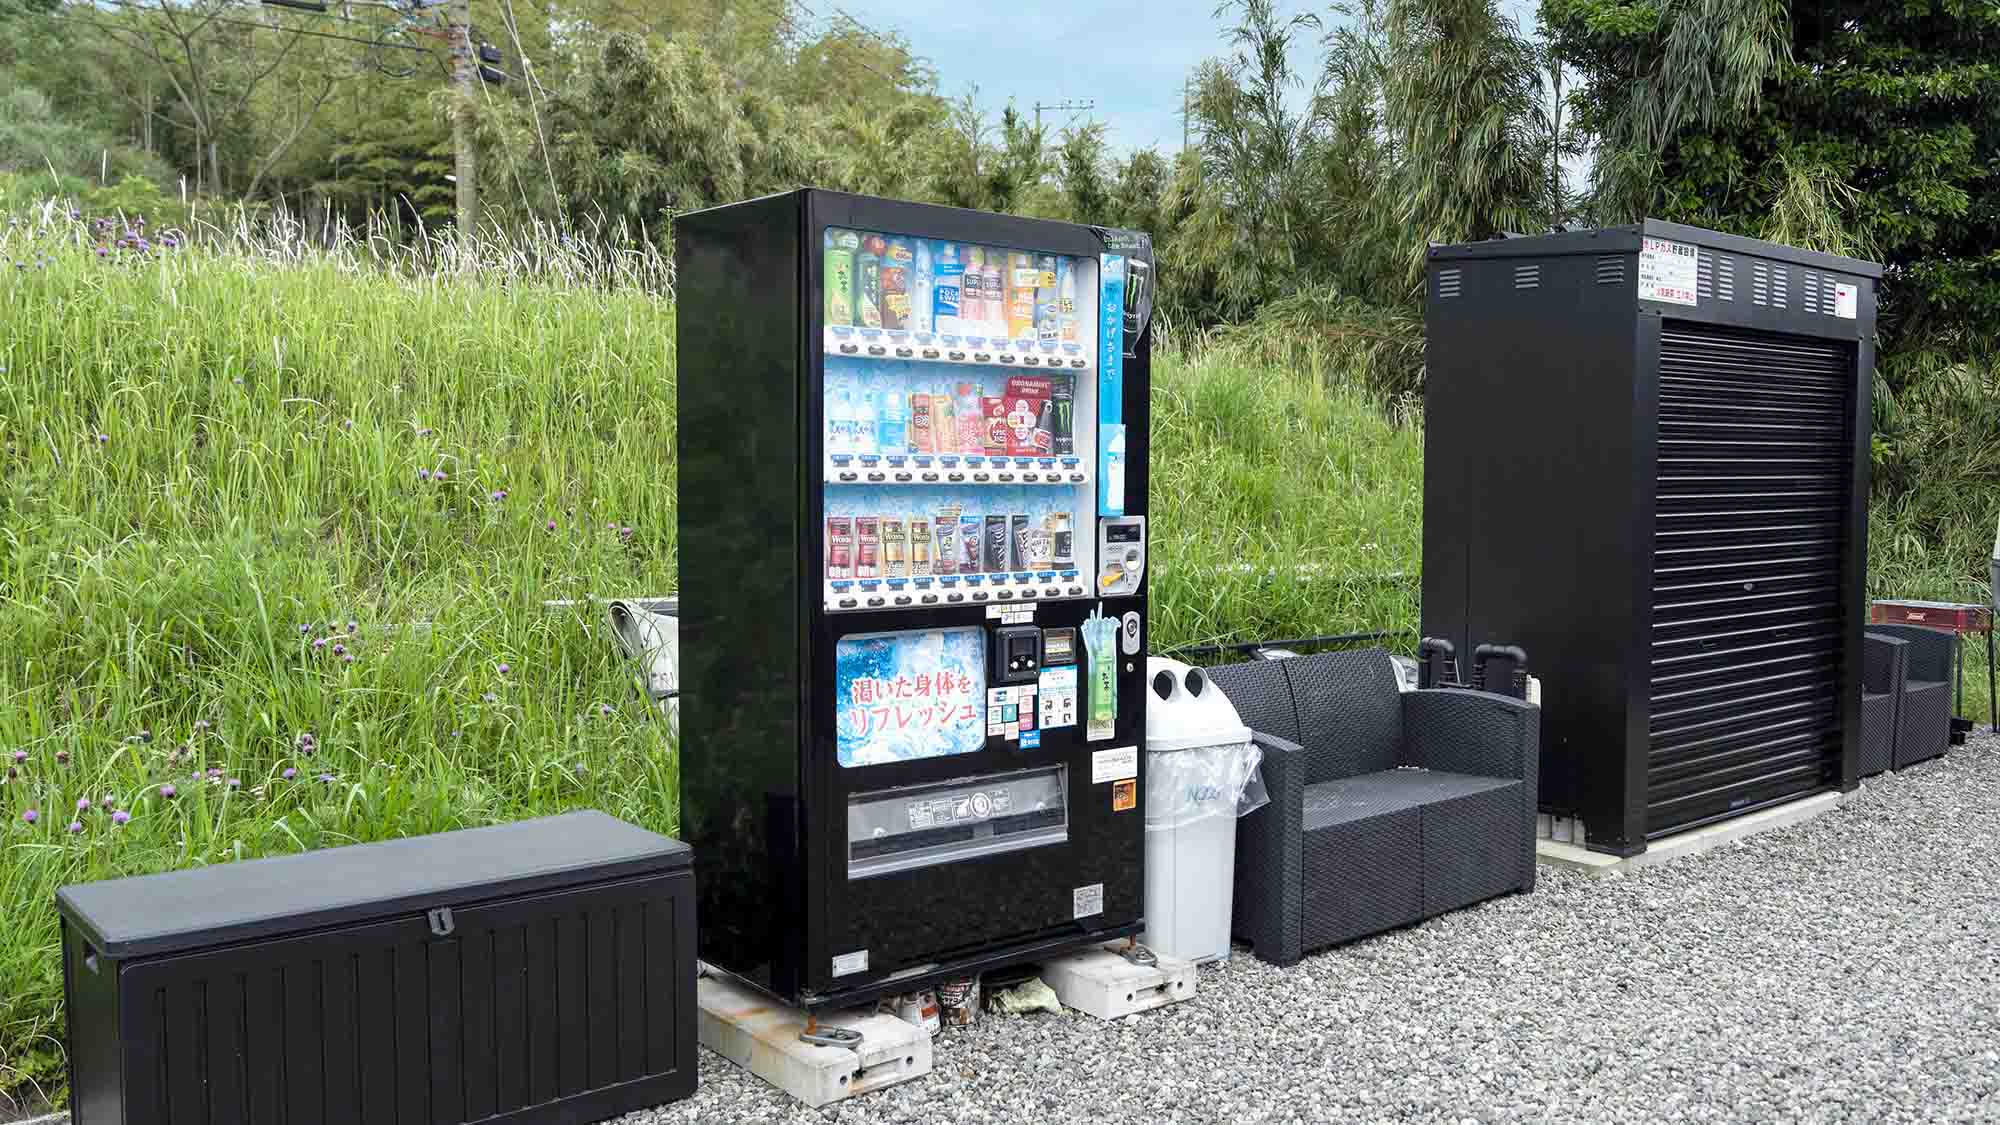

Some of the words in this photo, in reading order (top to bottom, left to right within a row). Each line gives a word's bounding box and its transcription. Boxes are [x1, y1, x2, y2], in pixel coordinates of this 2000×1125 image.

[853, 671, 971, 704] 渇いた身体を
[851, 700, 977, 735] リフレッシュ
